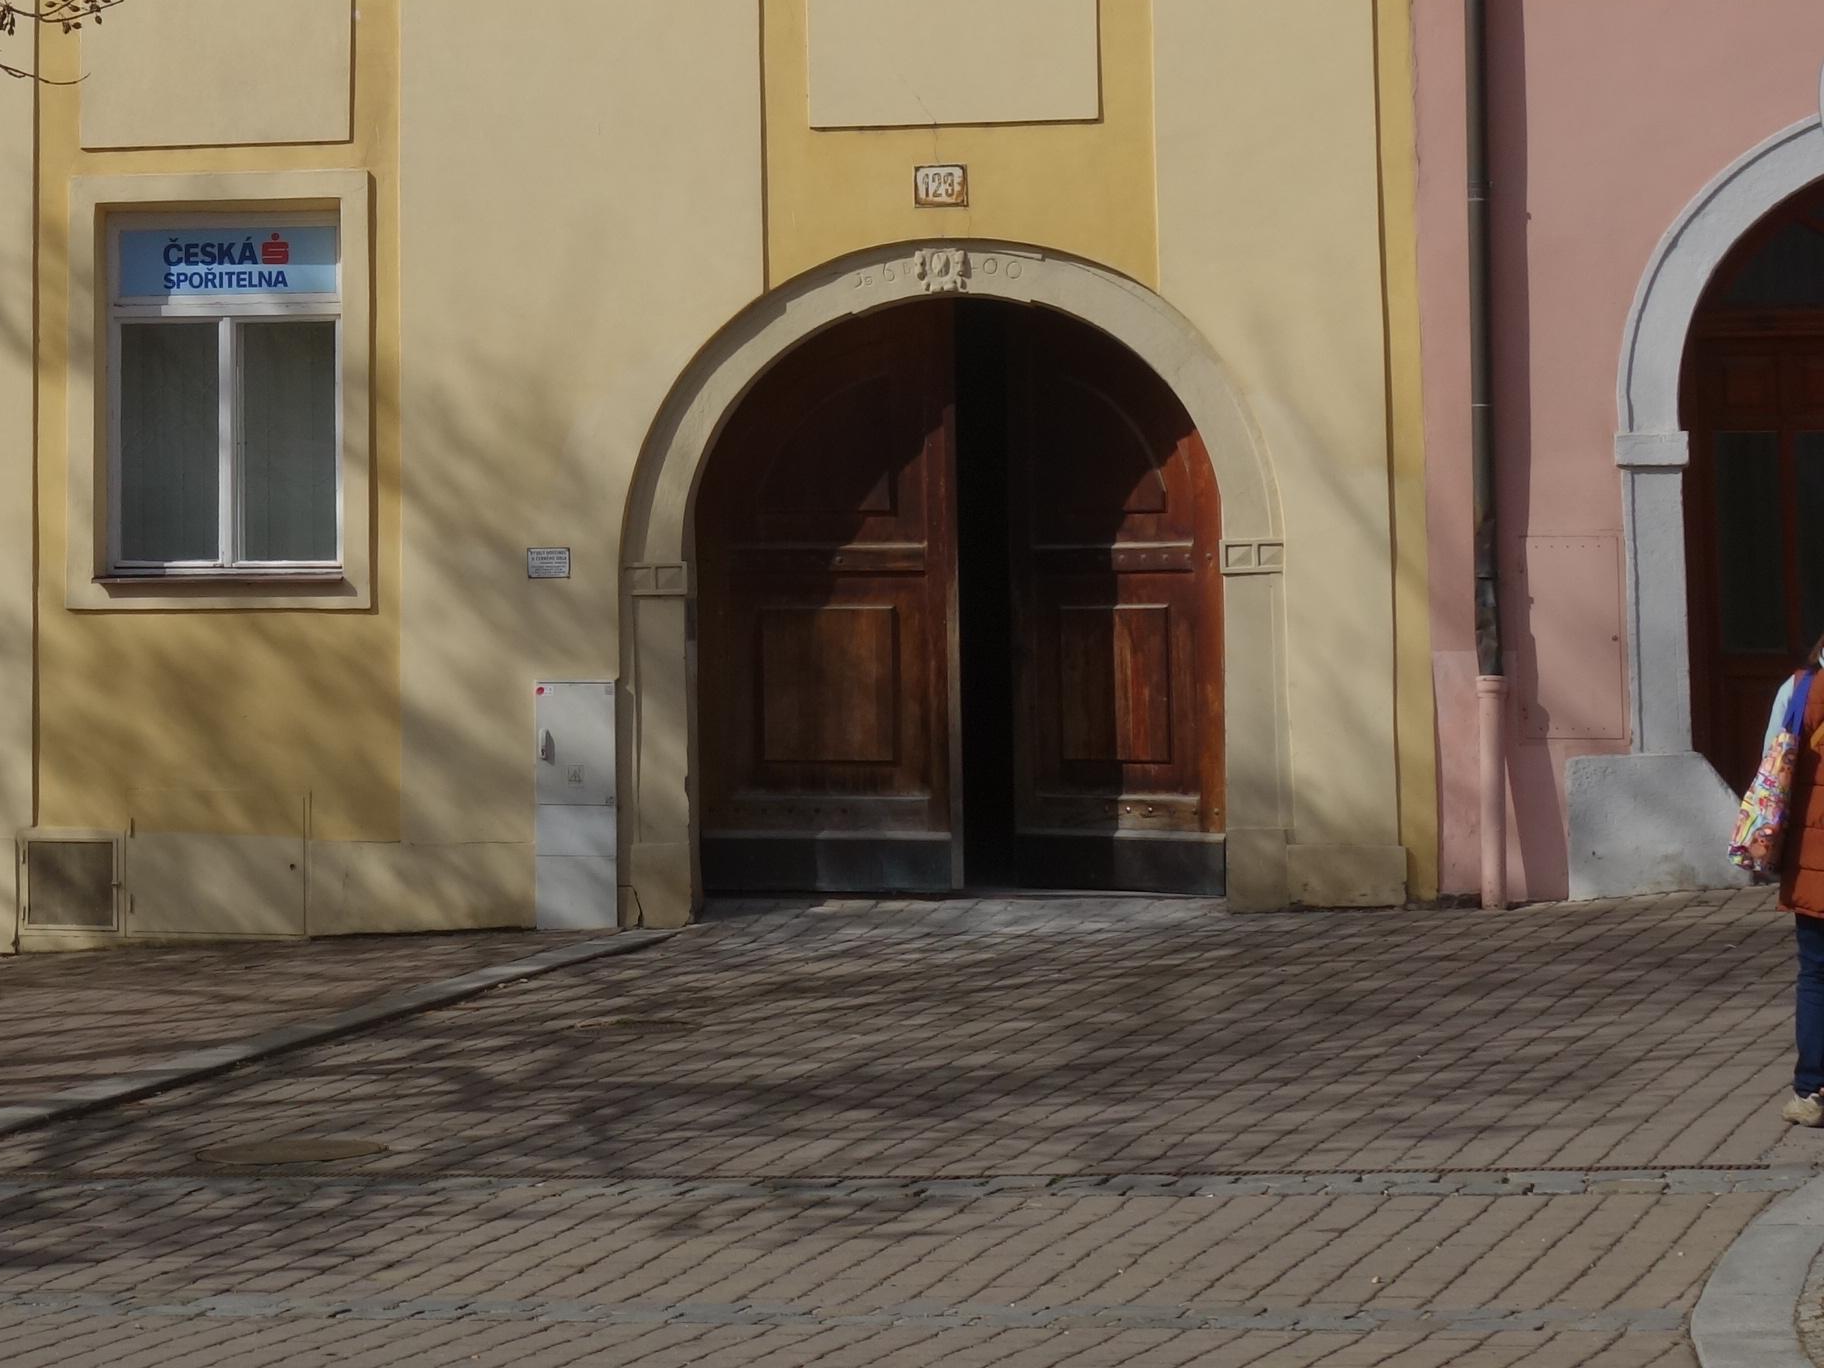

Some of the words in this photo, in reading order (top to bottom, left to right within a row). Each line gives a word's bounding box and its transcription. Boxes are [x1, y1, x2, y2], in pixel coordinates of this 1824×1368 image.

[922, 172, 955, 198] 123
[163, 236, 258, 266] ČESKÁ
[163, 267, 288, 289] SPOŘITELNA
